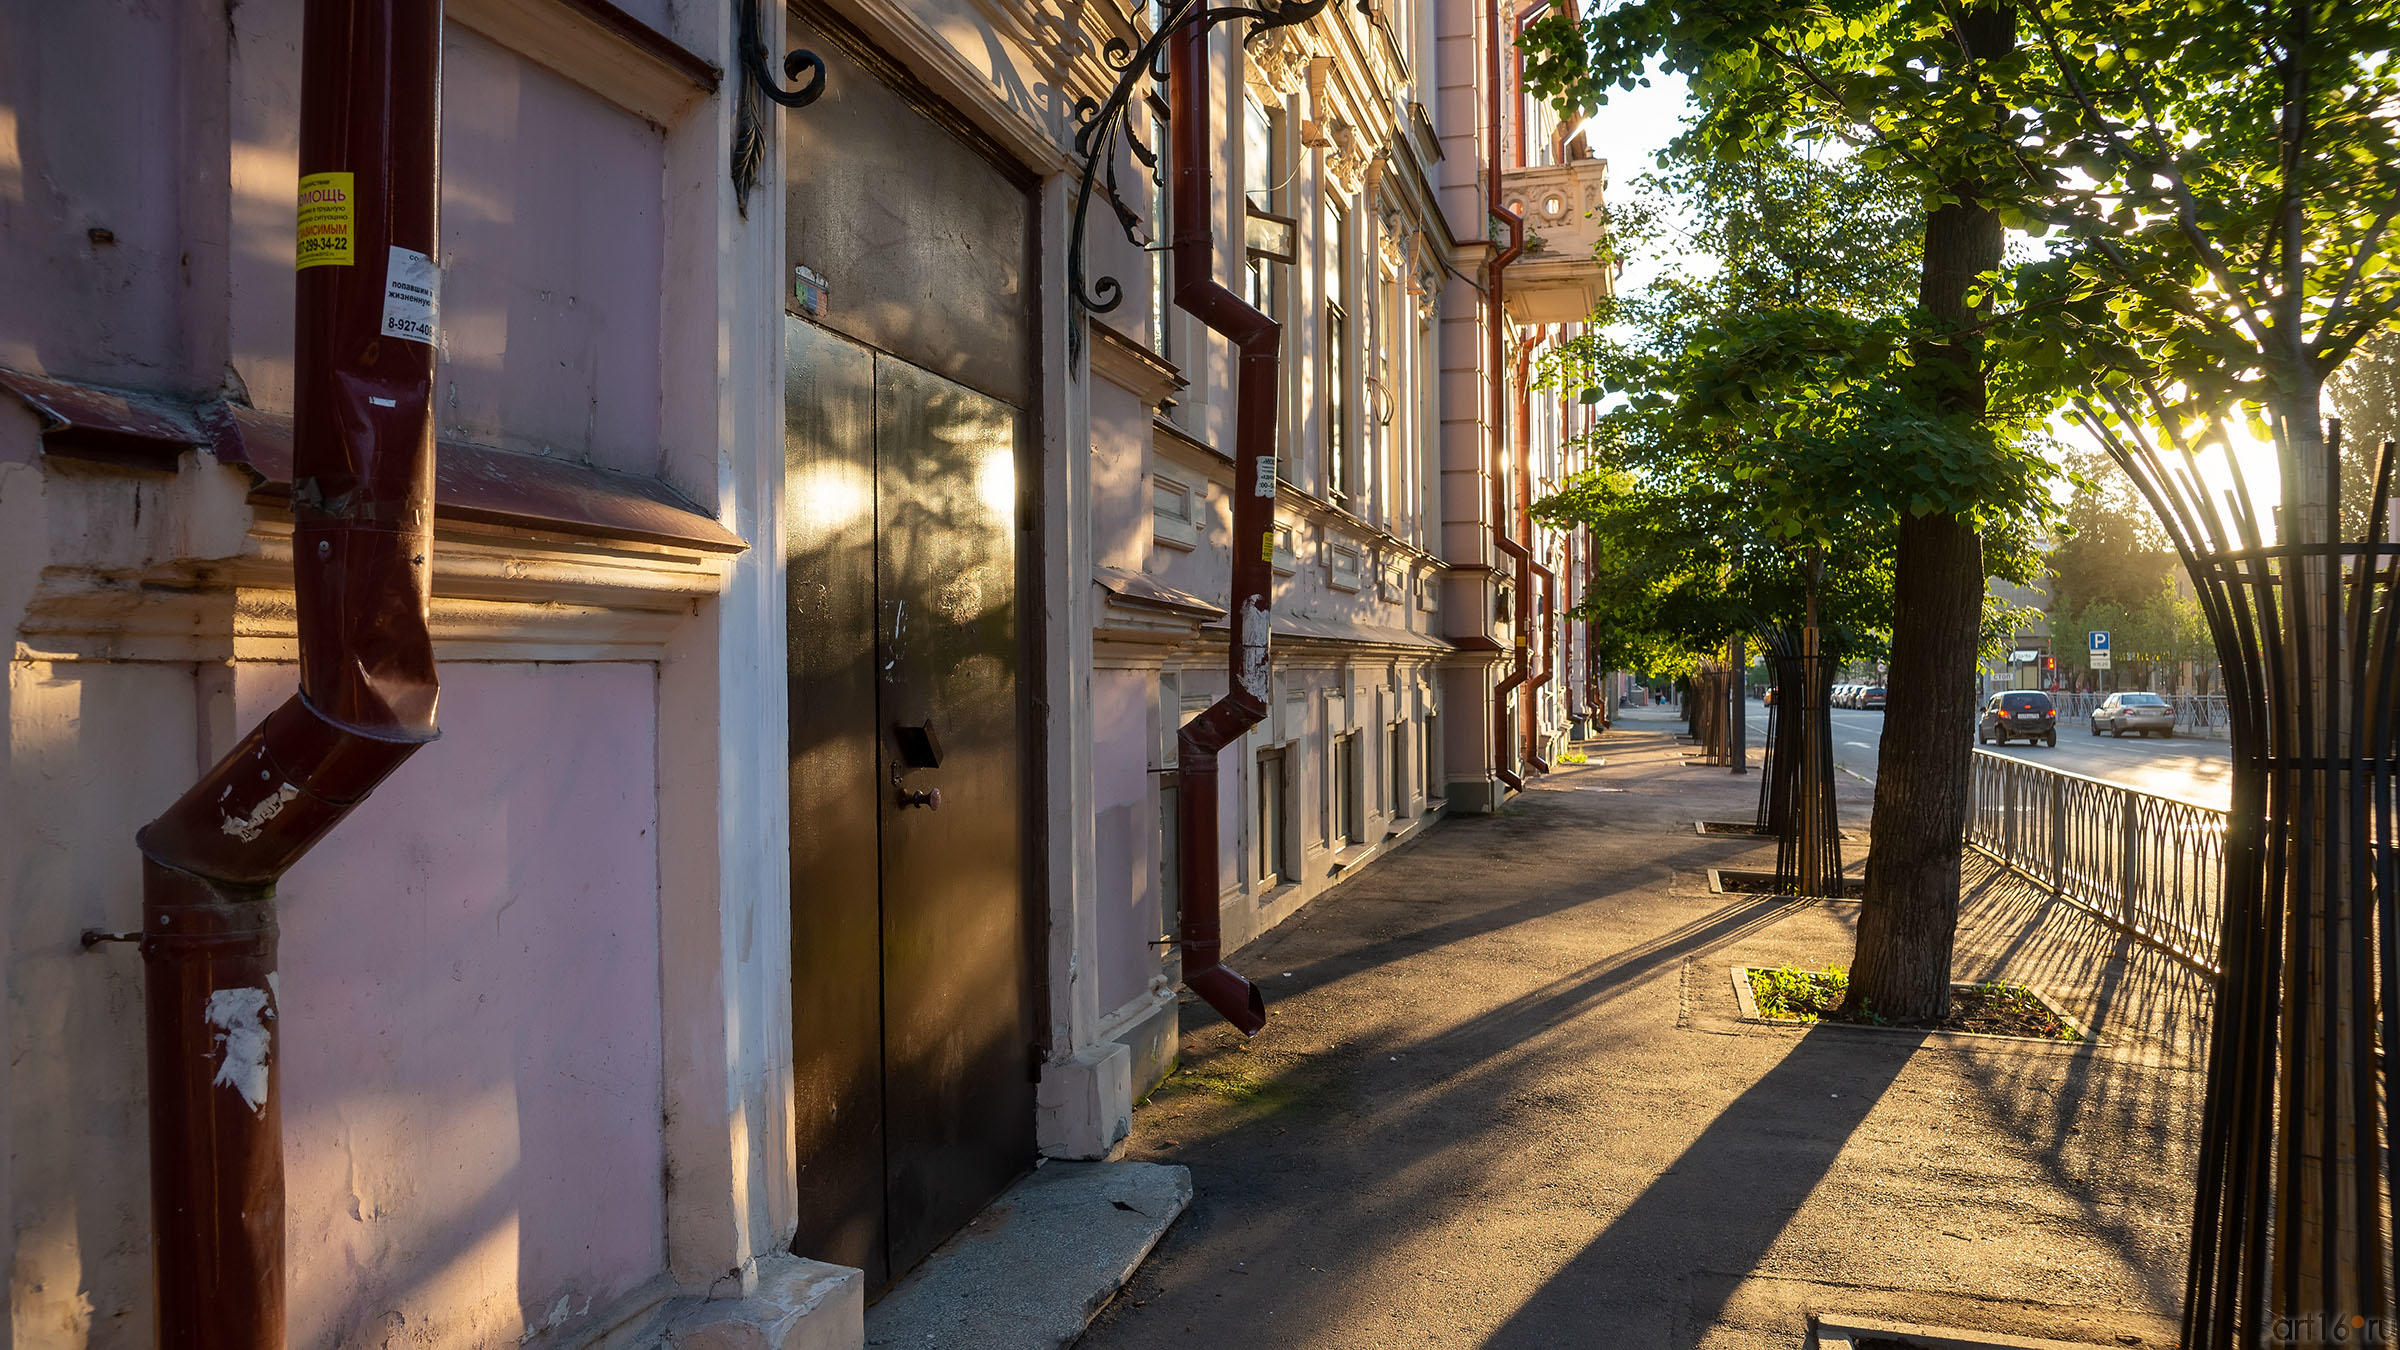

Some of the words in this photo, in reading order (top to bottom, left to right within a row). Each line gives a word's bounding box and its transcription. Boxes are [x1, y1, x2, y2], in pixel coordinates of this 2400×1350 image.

[298, 188, 346, 207] ОМОЩЬ
[392, 281, 429, 296] попавшим
[388, 290, 431, 307] жизненную
[2095, 633, 2106, 649] P
